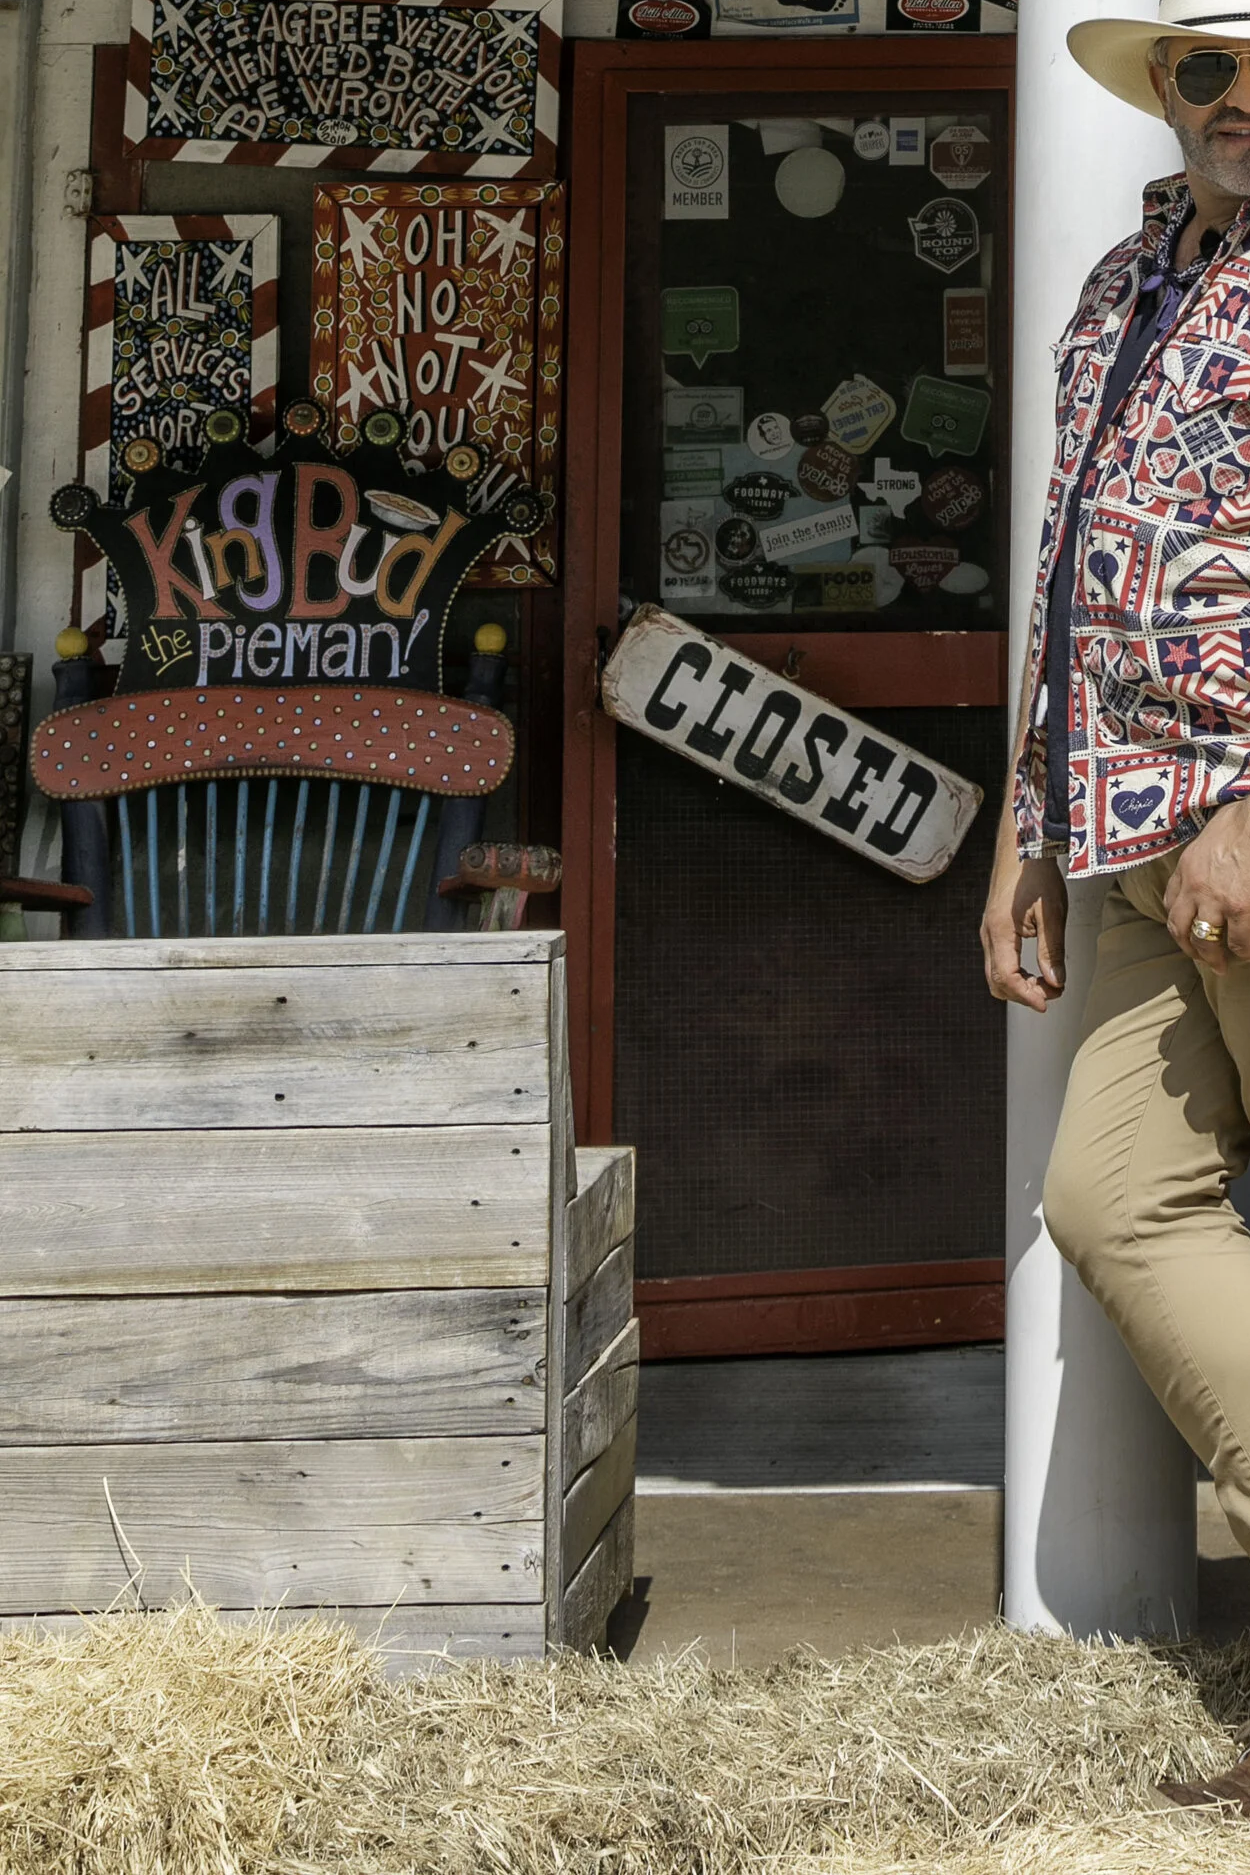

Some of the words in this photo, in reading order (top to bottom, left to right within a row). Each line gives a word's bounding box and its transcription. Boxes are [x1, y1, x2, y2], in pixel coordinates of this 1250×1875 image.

[196, 42, 278, 107] THEN
[285, 42, 373, 80] WE'D
[375, 44, 473, 115] BOTH
[257, 1, 382, 46] AGREE
[468, 41, 528, 110] YOU
[212, 79, 286, 142] BE
[298, 77, 440, 148] WRONG
[672, 192, 723, 205] MEMBER
[404, 208, 464, 267] OH
[922, 237, 973, 248] ROUND
[932, 247, 963, 256] TOP
[152, 252, 217, 322] ALL
[397, 271, 461, 334] NO
[113, 333, 250, 415] SERVICES
[374, 332, 483, 404] NOT
[399, 398, 465, 456] OU
[733, 487, 790, 499] FOODWAYS
[800, 463, 835, 493] yelp
[877, 479, 916, 491] STRONG
[766, 533, 790, 553] join
[792, 526, 812, 540] the
[814, 514, 852, 532] family
[936, 494, 970, 526] yelp
[123, 470, 284, 620] King
[287, 462, 470, 620] Bud
[730, 576, 787, 588] FOODWAYS
[823, 570, 873, 585] FOOD
[140, 627, 193, 665] the
[643, 640, 939, 857] CLOSED
